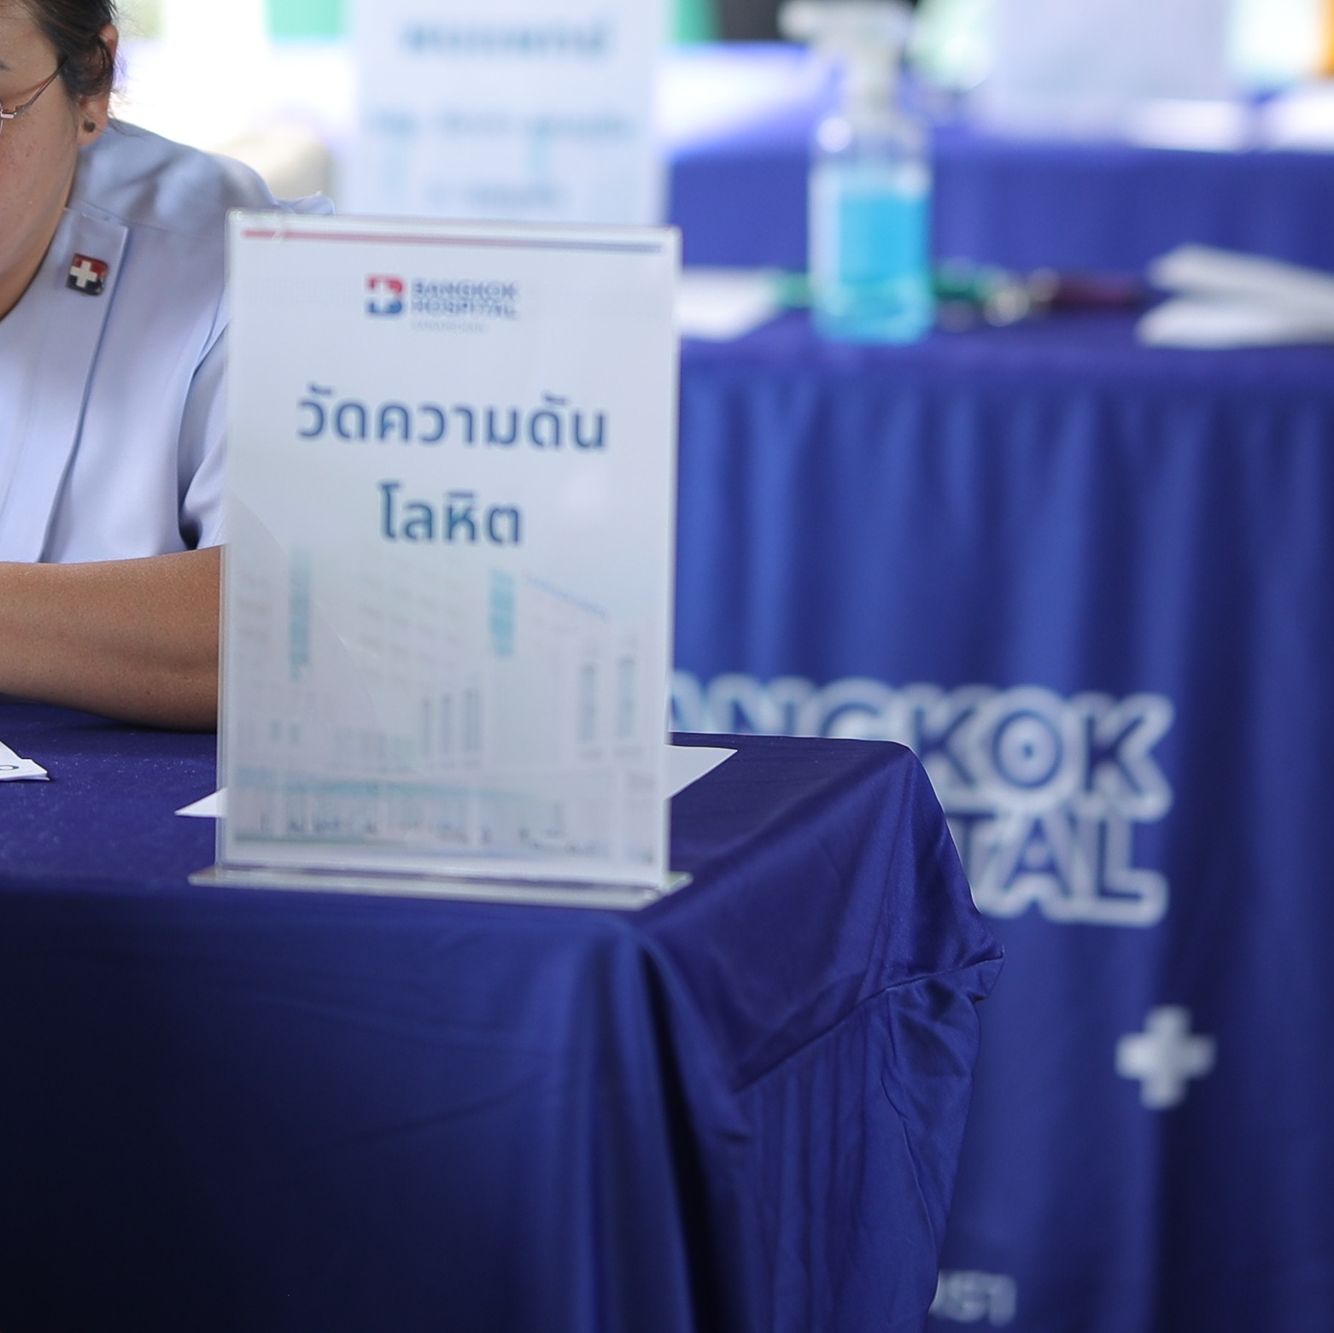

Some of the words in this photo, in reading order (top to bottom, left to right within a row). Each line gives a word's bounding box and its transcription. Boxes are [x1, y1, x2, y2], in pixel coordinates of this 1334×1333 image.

[413, 277, 519, 300] BANGKOK
[413, 299, 519, 321] HOSPITAL
[296, 381, 609, 451] วัดความดัน
[377, 479, 524, 548] โลหิต
